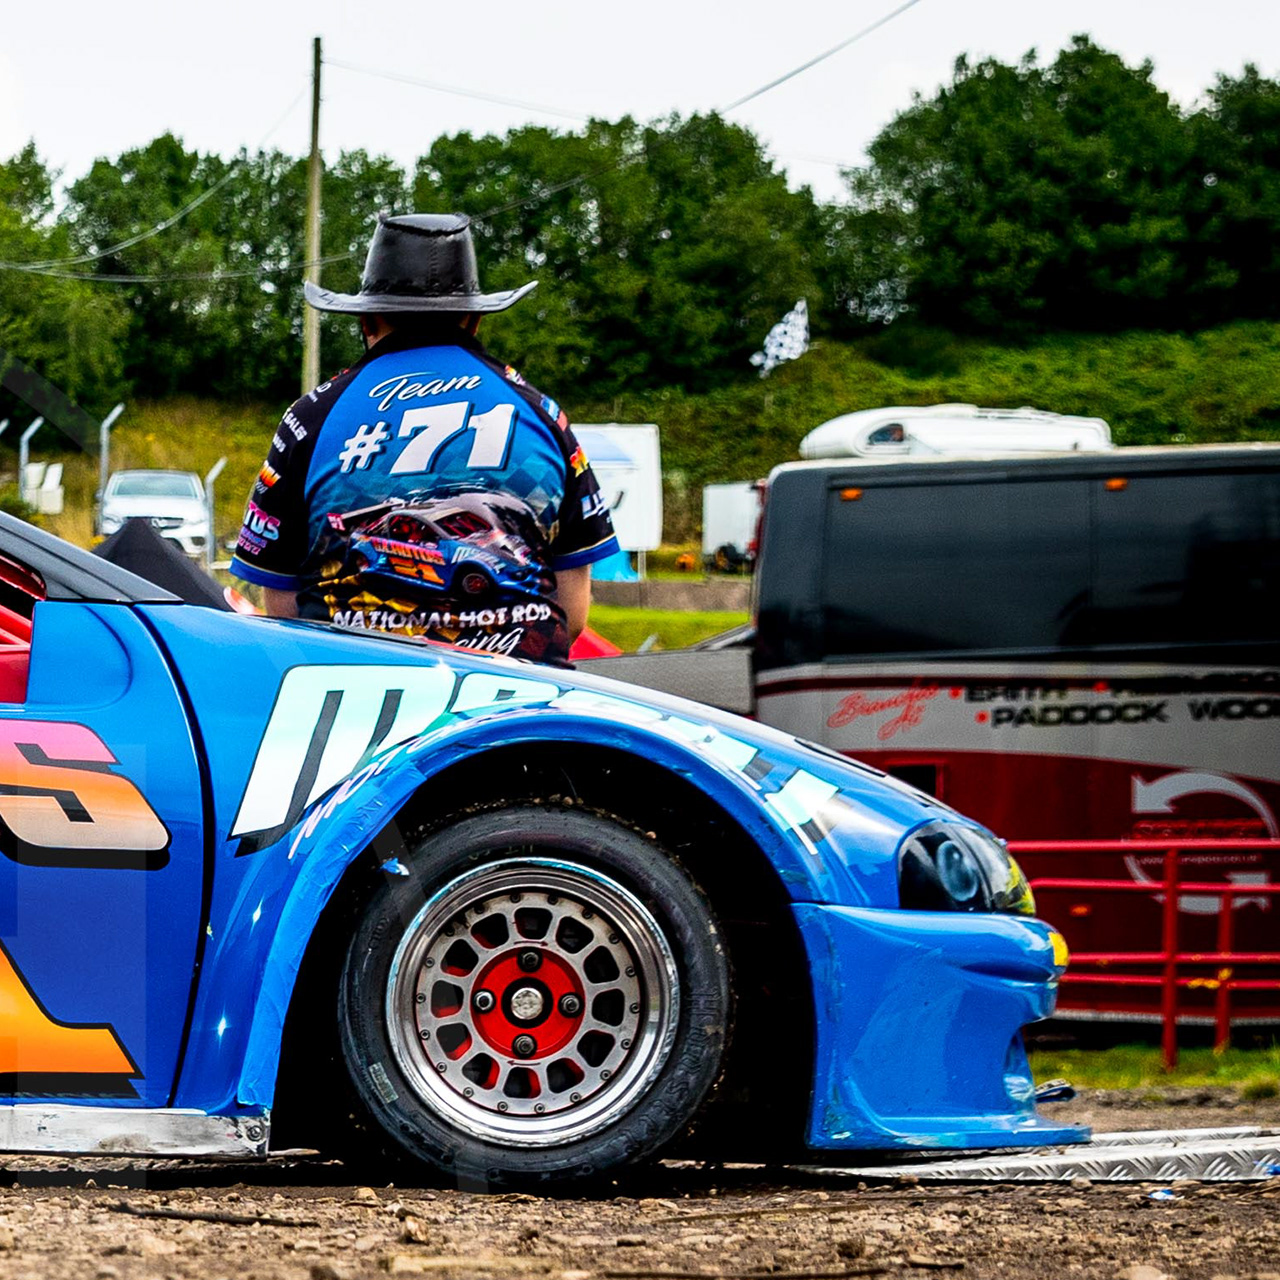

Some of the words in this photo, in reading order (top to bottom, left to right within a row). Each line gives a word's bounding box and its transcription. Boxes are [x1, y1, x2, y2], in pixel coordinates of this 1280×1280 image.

[368, 371, 482, 412] Team
[339, 401, 520, 476] #71
[332, 609, 455, 631] NATIONAL
[459, 607, 508, 628] HOT
[510, 602, 553, 624] ROD
[991, 701, 1169, 728] PADDOCK
